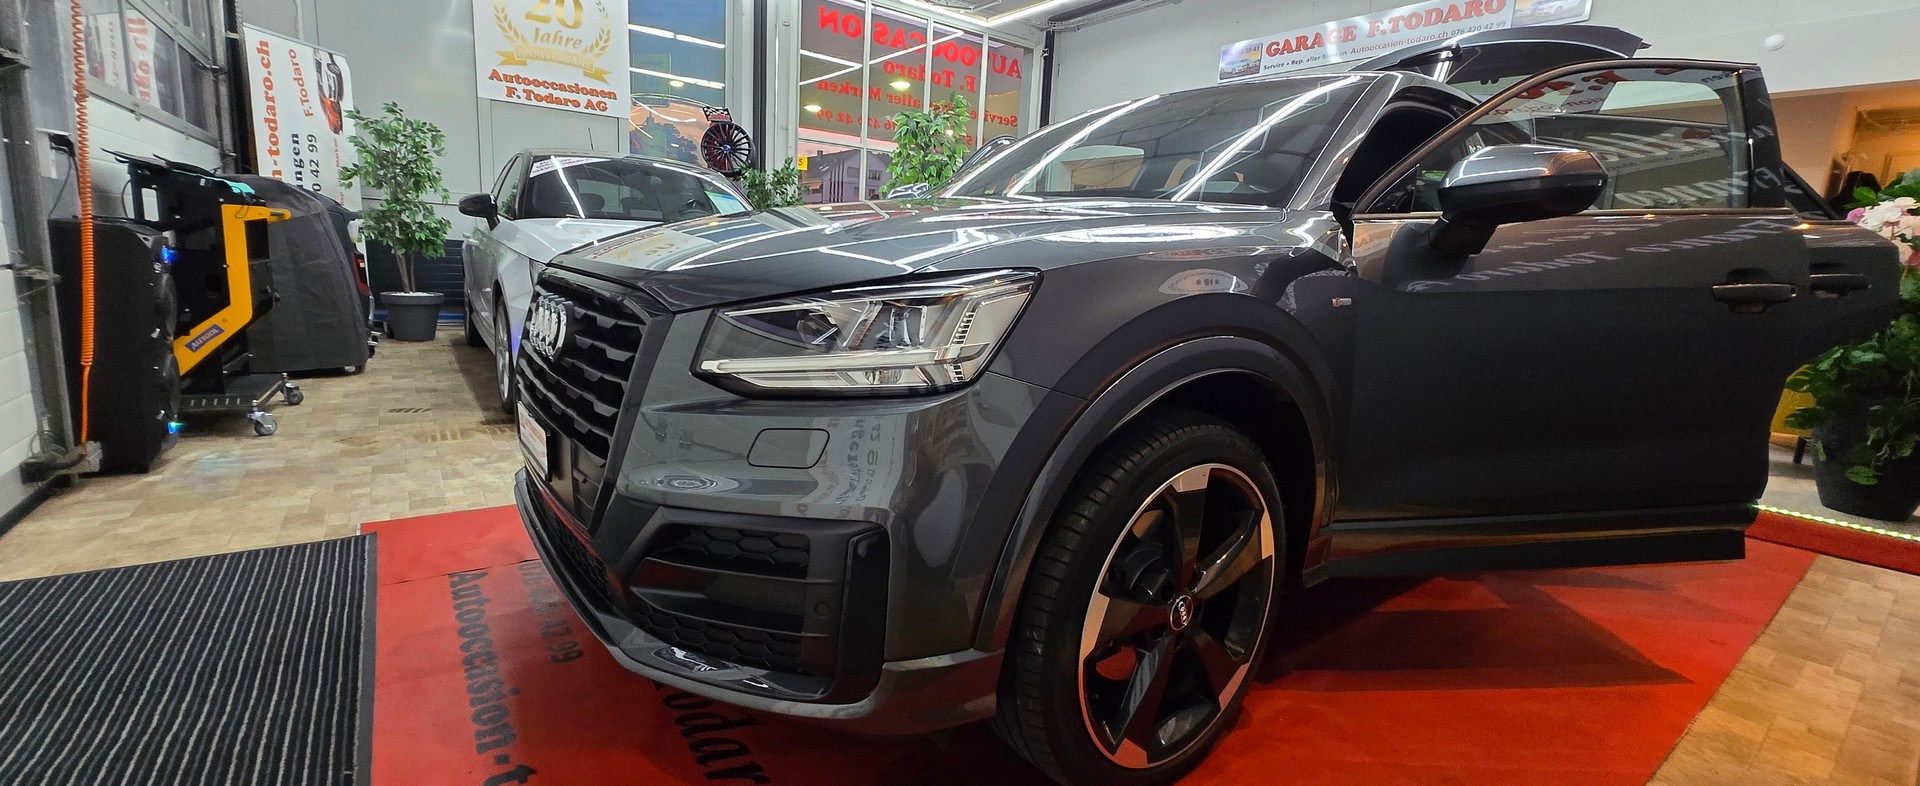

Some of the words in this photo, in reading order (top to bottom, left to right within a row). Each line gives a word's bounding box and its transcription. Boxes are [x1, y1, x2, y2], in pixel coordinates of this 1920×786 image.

[524, 0, 585, 30] 20
[1265, 25, 1357, 58] GARAGE
[1366, 0, 1507, 39] F.TODARO
[531, 26, 583, 50] Jahre
[1263, 61, 1285, 71] Service
[1306, 54, 1321, 63] aller
[1350, 30, 1448, 55] Autooccasion-todaro.ch
[1450, 27, 1466, 36] 076
[1466, 24, 1482, 34] 420
[1483, 22, 1494, 32] 42
[1495, 20, 1507, 29] 99
[488, 68, 618, 100] Autooccasionen
[505, 85, 521, 99] F.
[522, 89, 581, 109] Todaro
[583, 98, 609, 112] AG
[306, 133, 318, 154] 99
[309, 159, 320, 178] 42
[191, 326, 220, 351] AUTOOL
[655, 680, 772, 785] odar
